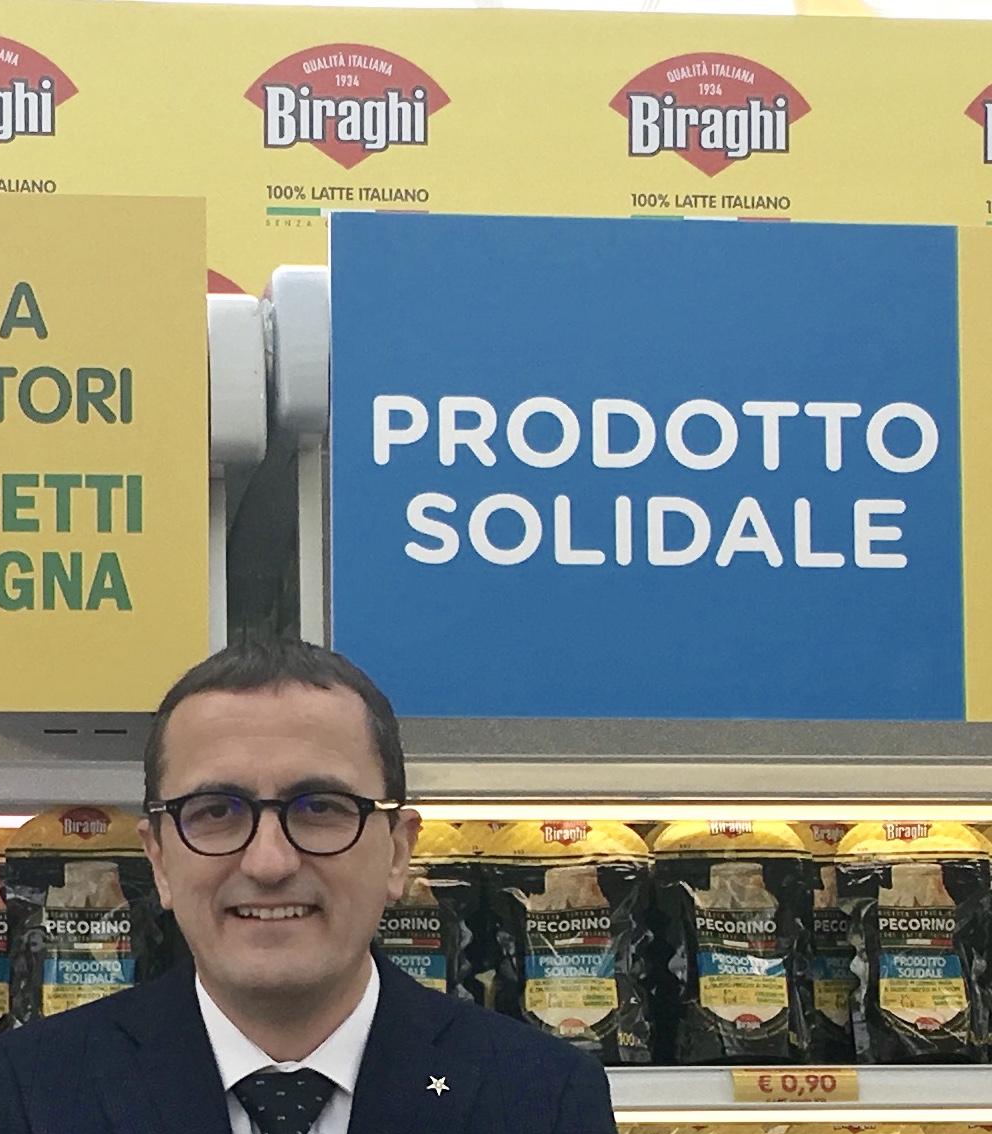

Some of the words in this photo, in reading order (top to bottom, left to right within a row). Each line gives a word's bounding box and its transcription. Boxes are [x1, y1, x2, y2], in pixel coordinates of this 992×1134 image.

[348, 55, 393, 76] ITALIANA
[335, 75, 359, 86] 1934
[711, 64, 755, 84] ITALIANA
[699, 84, 722, 96] 1934
[264, 85, 427, 151] Biraghi
[629, 93, 789, 159] Biraghi
[266, 186, 306, 200] 100%
[311, 187, 353, 201] LATTE
[359, 188, 429, 202] ITALIANO
[631, 194, 670, 207] 100%
[675, 195, 716, 208] LATTE
[722, 196, 791, 210] ITALIANO
[372, 395, 939, 474] PRODOTTO
[405, 492, 908, 569] SOLIDALE
[544, 827, 587, 843] Biraghi
[886, 824, 928, 840] Biraghi
[45, 920, 131, 933] PECORINO
[526, 916, 611, 932] PECORINO
[696, 918, 776, 933] PECORINO
[879, 918, 955, 932] PECORINO
[758, 1075, 773, 1092] €
[782, 1075, 836, 1096] 0,90
